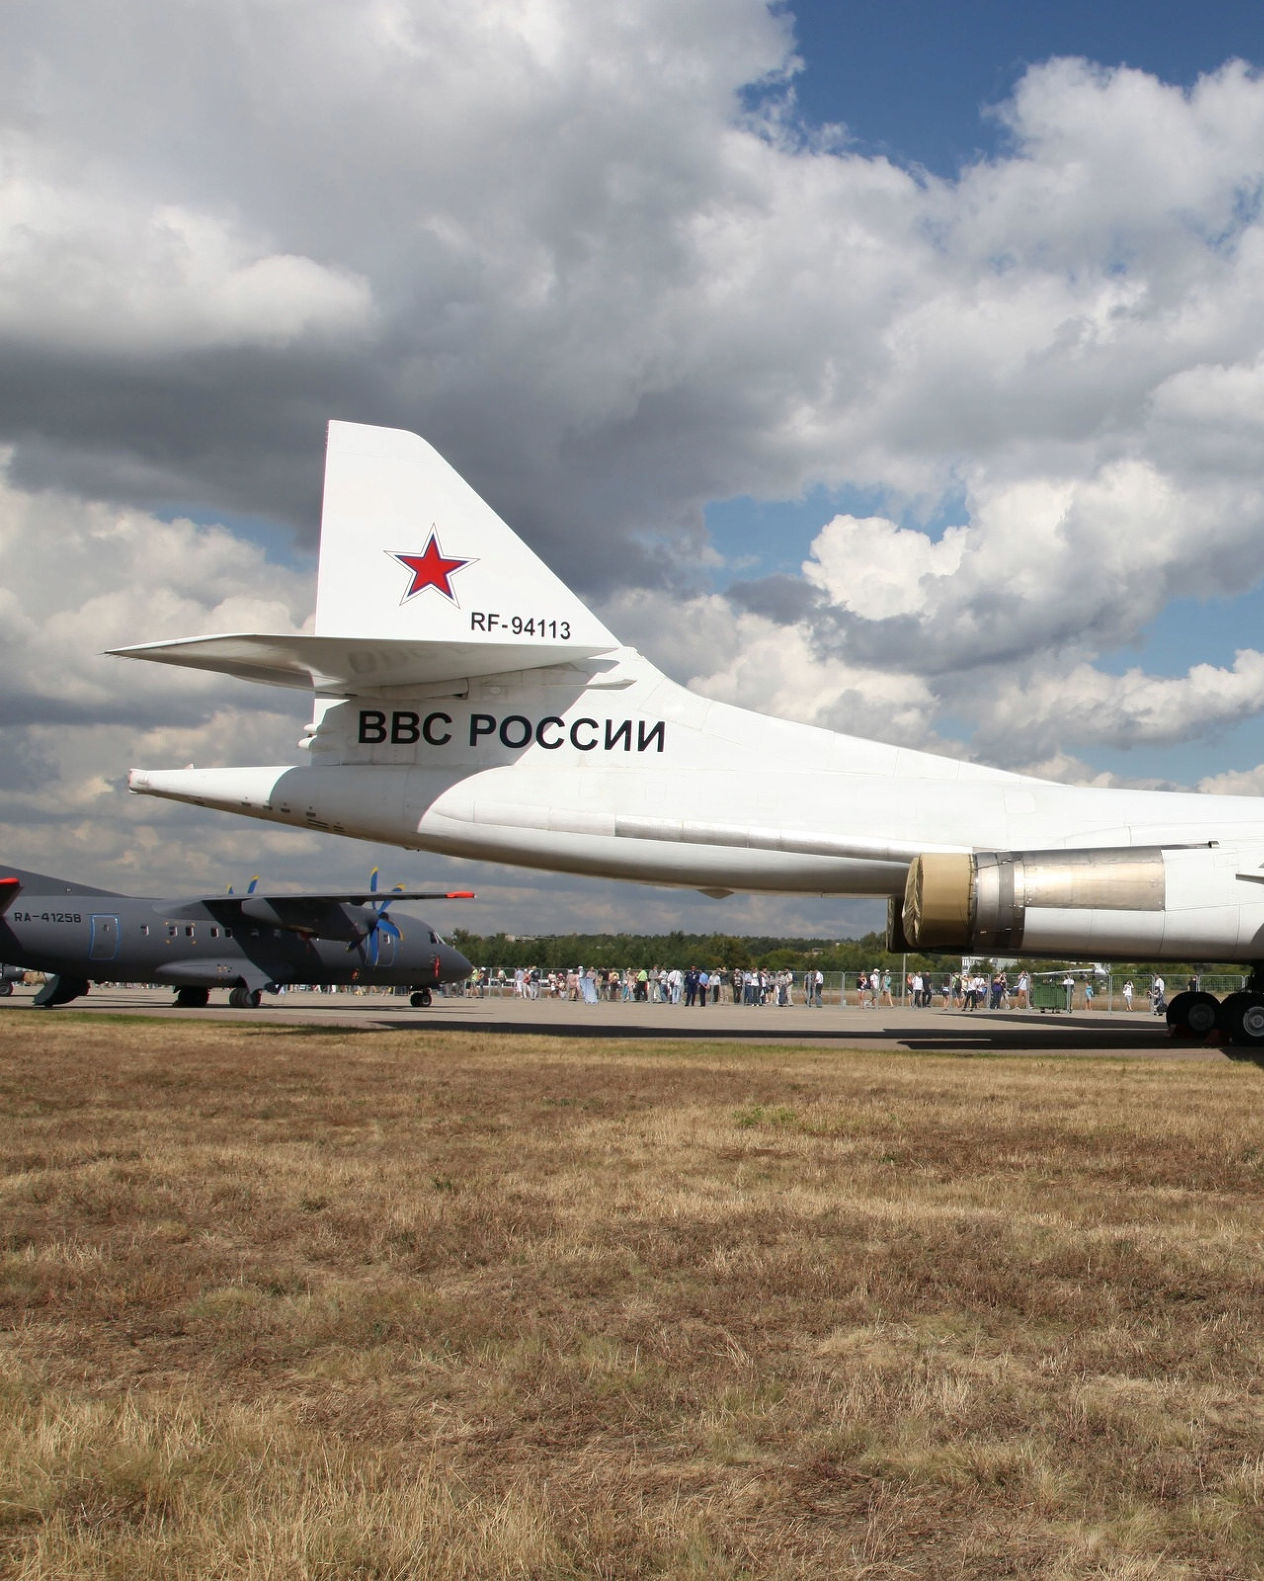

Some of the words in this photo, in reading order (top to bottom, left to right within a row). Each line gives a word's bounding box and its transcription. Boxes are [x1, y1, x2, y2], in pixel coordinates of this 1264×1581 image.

[470, 612, 571, 640] RF-94113
[358, 710, 452, 745] ВВС
[469, 713, 666, 753] РОССИИ
